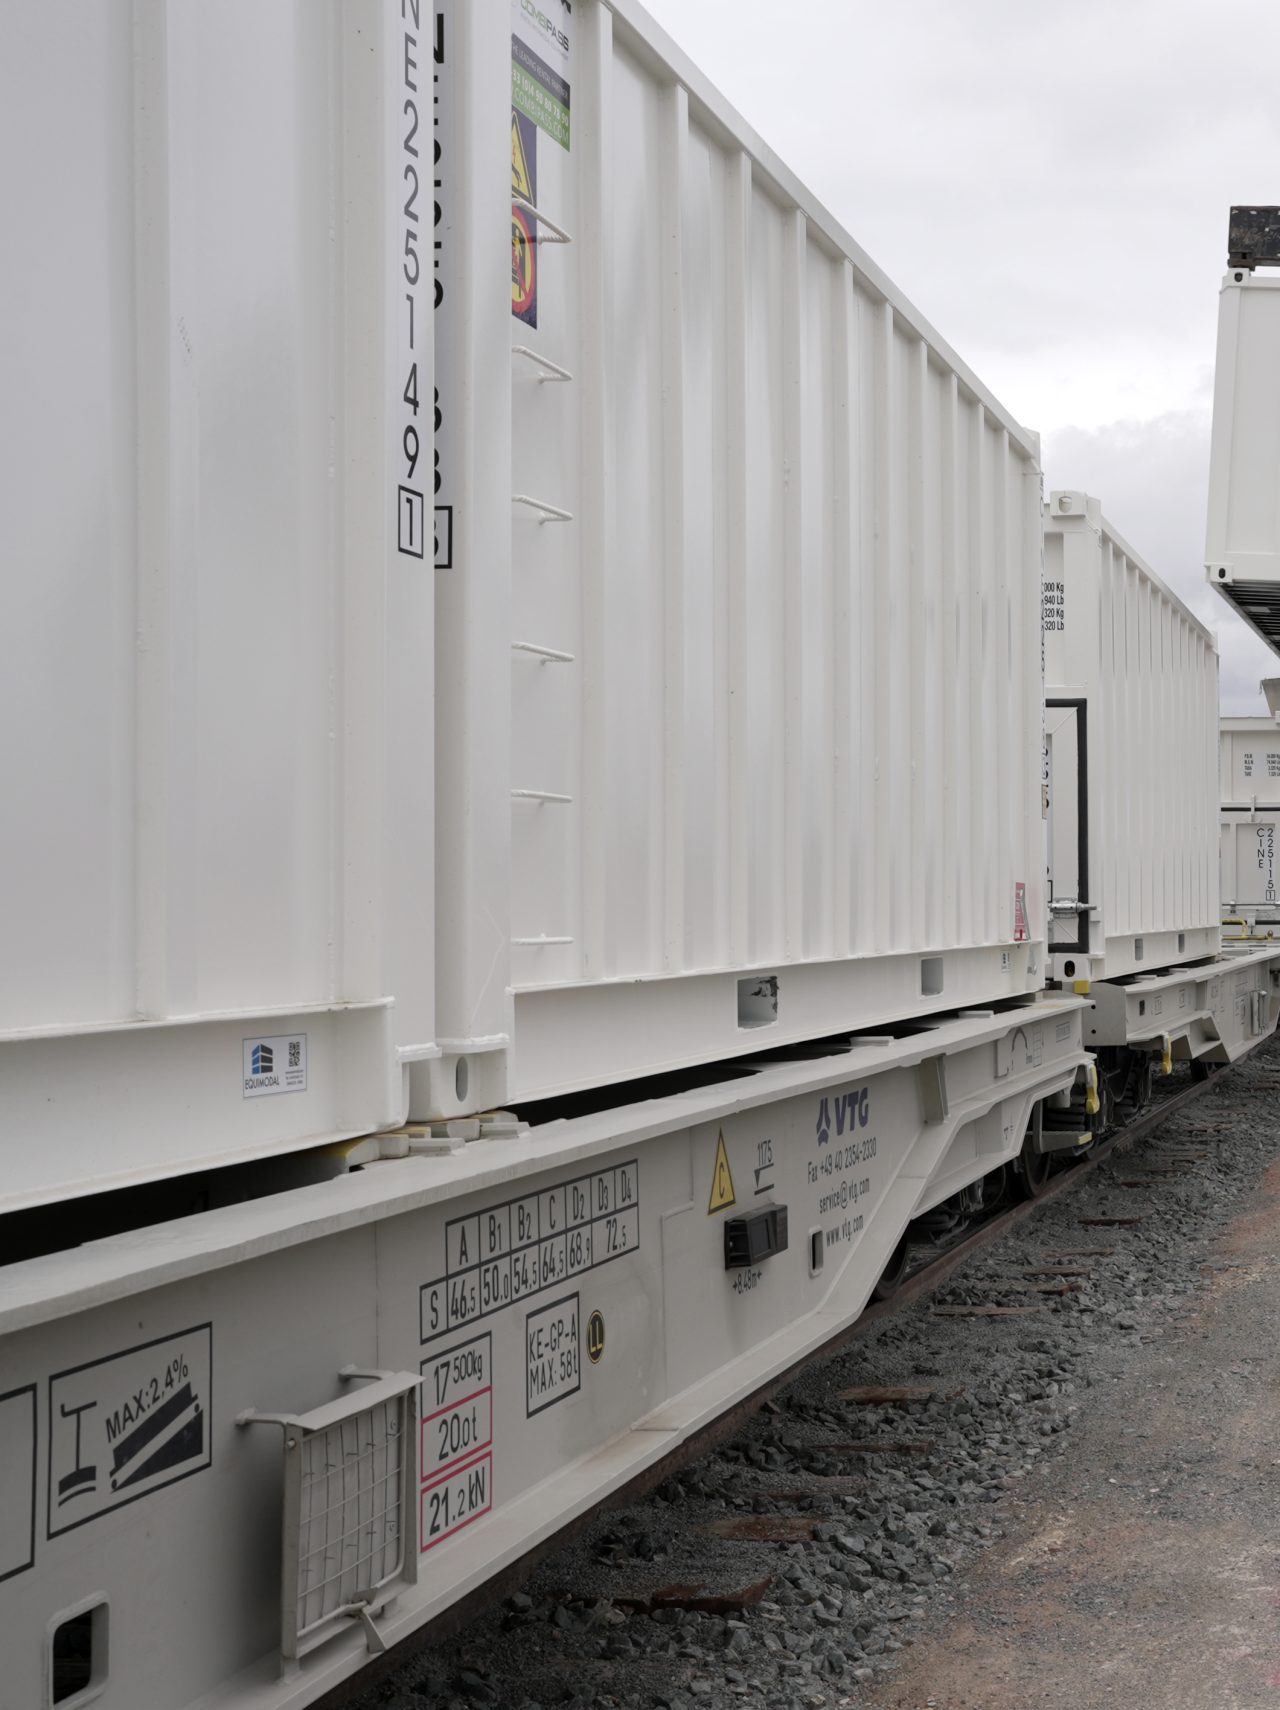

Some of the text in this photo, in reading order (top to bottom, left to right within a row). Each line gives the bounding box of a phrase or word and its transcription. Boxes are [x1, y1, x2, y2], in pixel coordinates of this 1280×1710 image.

[1056, 582, 1064, 594] Kg
[1057, 595, 1064, 605] Lb
[1056, 608, 1064, 620] Kg
[1057, 621, 1064, 631] Lb
[1256, 827, 1265, 869] CINE
[244, 1075, 280, 1090] EQUIMODAL
[834, 1087, 869, 1136] VTG
[757, 1139, 773, 1167] 1175
[808, 1161, 818, 1184] Fax
[820, 1153, 833, 1176] +49
[834, 1150, 843, 1173] 40
[718, 1161, 726, 1200] C
[459, 1169, 632, 1265] A B1 B2 C D2 D3 D4
[430, 1290, 439, 1330] S
[529, 1312, 577, 1364] KE-GP-A
